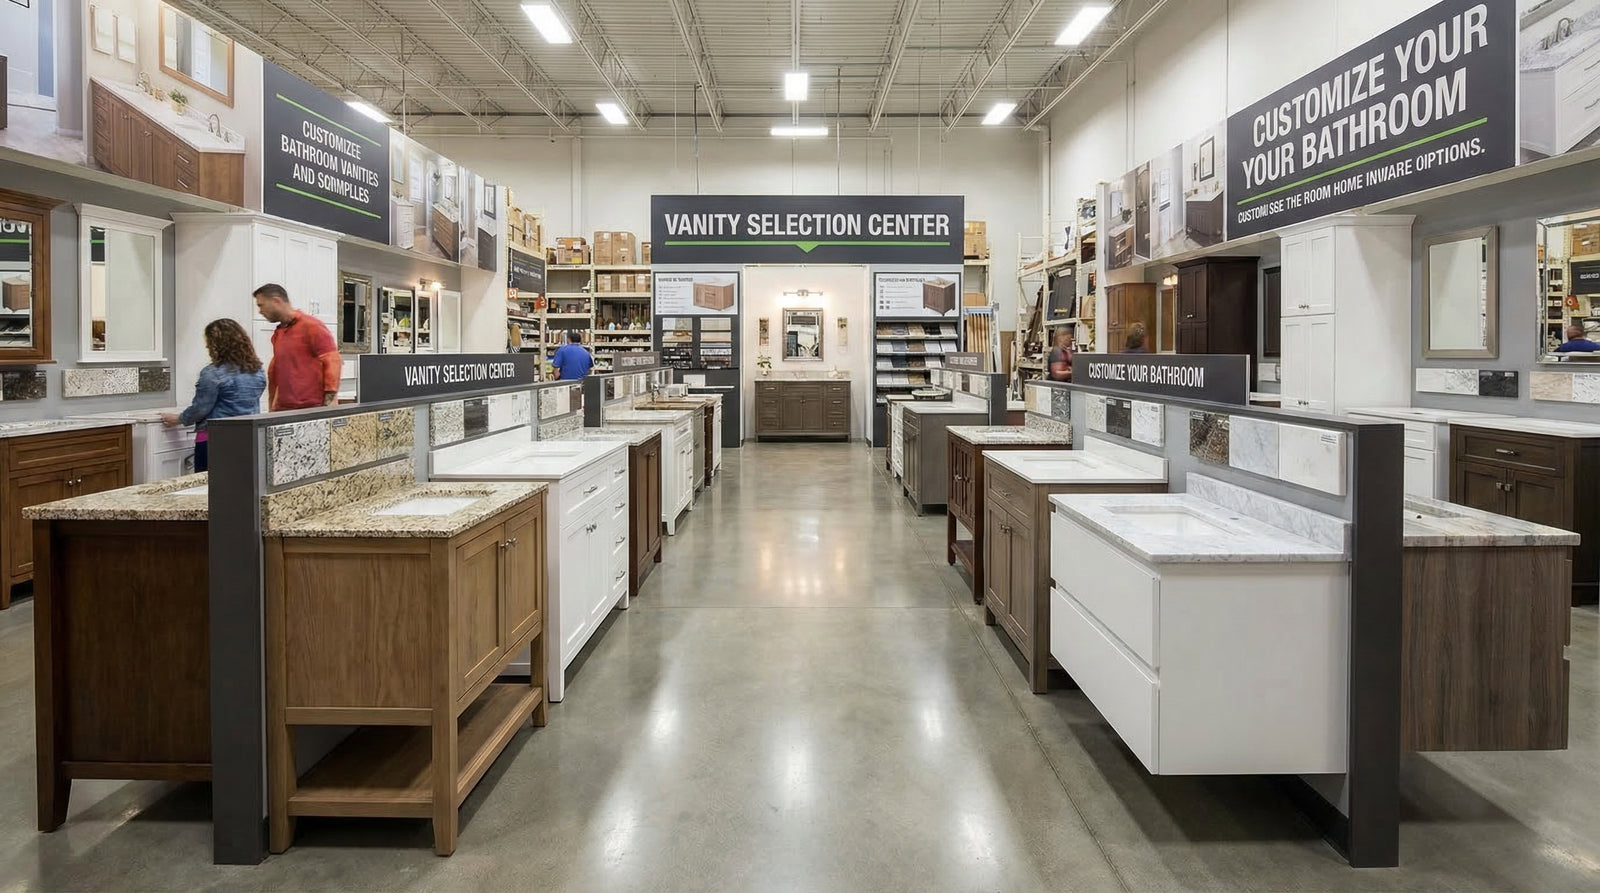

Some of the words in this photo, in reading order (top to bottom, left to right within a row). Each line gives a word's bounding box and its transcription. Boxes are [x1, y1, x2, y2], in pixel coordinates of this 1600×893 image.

[1253, 53, 1385, 147] CUSTOMIZE
[1394, 4, 1488, 83] YOUR
[303, 121, 361, 160] CUSTOMIZEE
[1242, 142, 1295, 189] YOUR
[1302, 67, 1467, 170] BATHROOM
[281, 134, 338, 172] BATHROOM
[340, 158, 379, 187] VANITIES
[293, 163, 315, 185] AND
[1286, 194, 1302, 209] THE
[1304, 184, 1331, 205] ROOM
[1333, 174, 1363, 196] HOME
[664, 213, 741, 236] VANITY
[747, 213, 861, 236] SELECTION
[868, 213, 949, 236] CENTER
[404, 365, 441, 386] VANITY
[443, 363, 488, 383] SELECTION
[489, 362, 515, 379] CENTER
[1088, 362, 1125, 380] CUSTOMIZE
[1127, 364, 1148, 382] YOUR
[1150, 365, 1204, 388] BATHROOM
